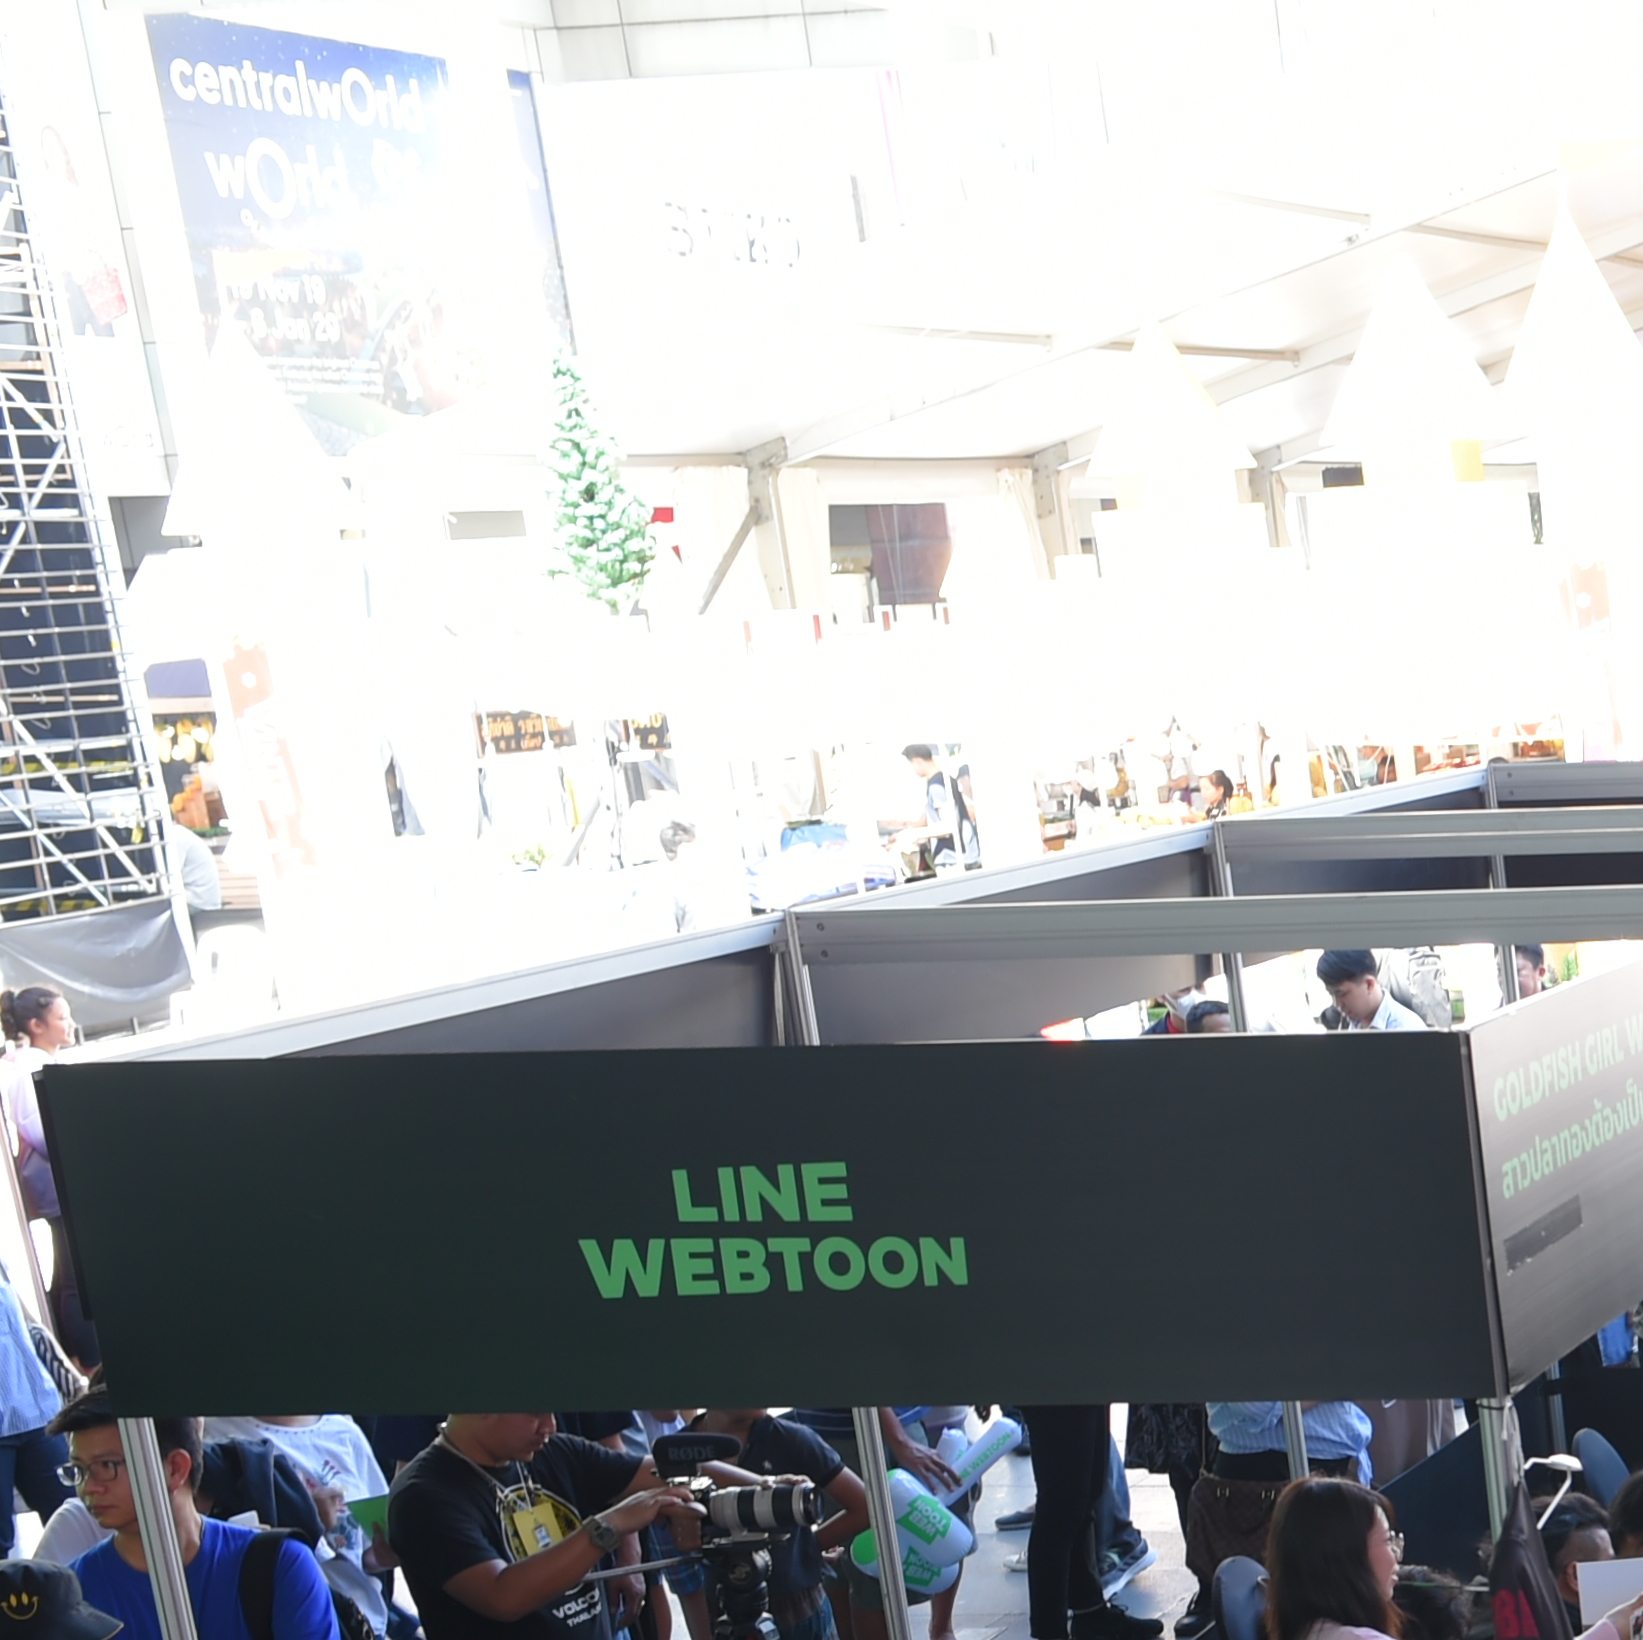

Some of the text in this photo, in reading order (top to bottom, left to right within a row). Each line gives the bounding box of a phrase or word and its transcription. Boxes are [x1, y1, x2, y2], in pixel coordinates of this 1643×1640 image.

[271, 308, 312, 342] Jan
[1493, 1041, 1583, 1122] GOLDFISH
[1585, 1022, 1625, 1076] GIRL
[672, 1161, 853, 1223] LINE
[578, 1236, 969, 1298] WEBTOON
[667, 1443, 716, 1461] RØDE
[551, 1587, 601, 1620] VOLCO
